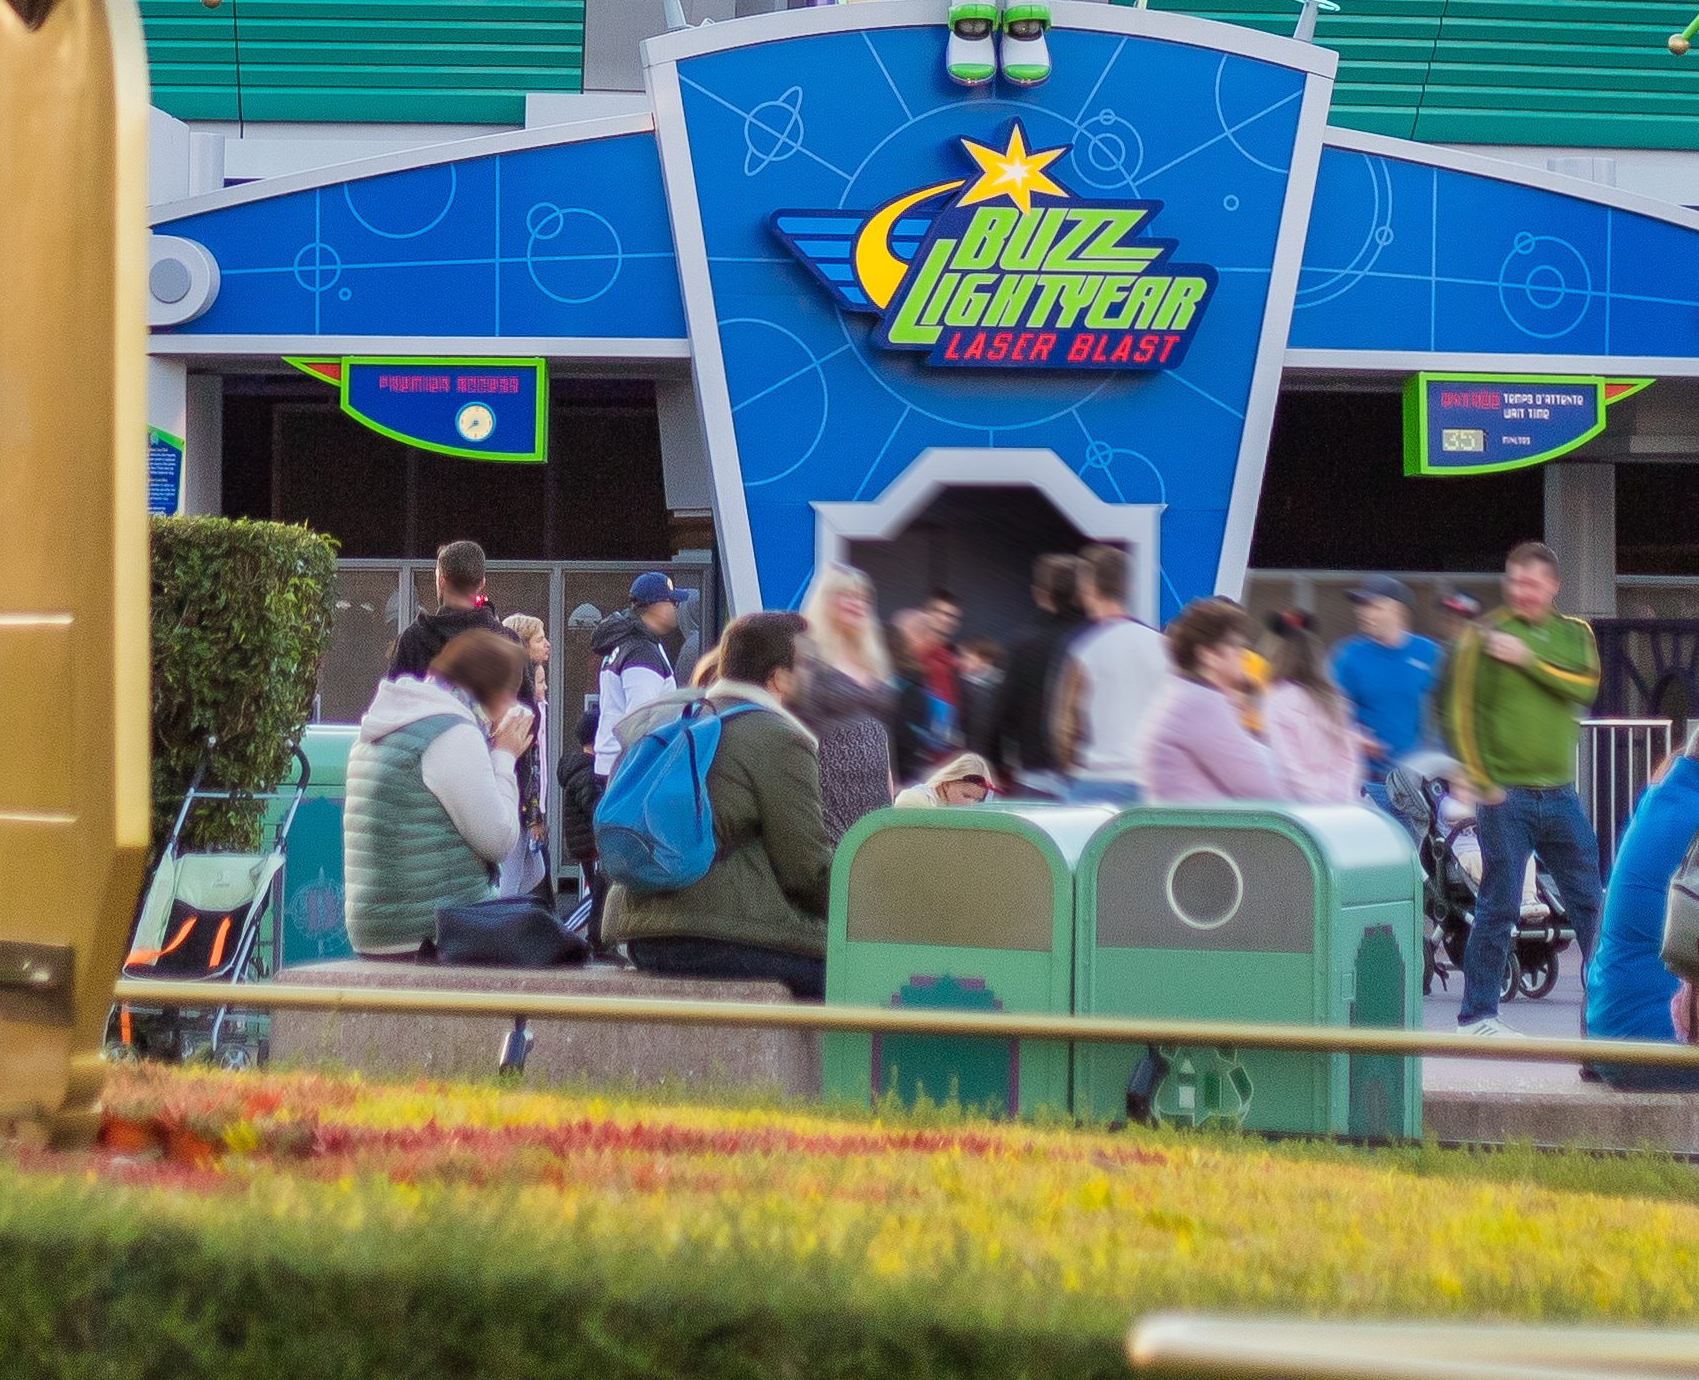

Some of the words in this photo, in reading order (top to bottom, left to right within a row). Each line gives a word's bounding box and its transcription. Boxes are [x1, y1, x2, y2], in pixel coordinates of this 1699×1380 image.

[949, 208, 1164, 273] BUZZ
[888, 239, 1208, 345] LIGHTYEAR
[944, 333, 1055, 362] LASER
[1067, 334, 1181, 364] BLAST
[379, 375, 450, 392] PREMIER
[456, 376, 519, 393] ACCESS
[1503, 393, 1533, 405] TEMPS
[1535, 394, 1584, 406] D'ATTENTE
[1503, 408, 1525, 419] WAIT
[1528, 408, 1550, 420] TIME
[1445, 430, 1476, 451] 35
